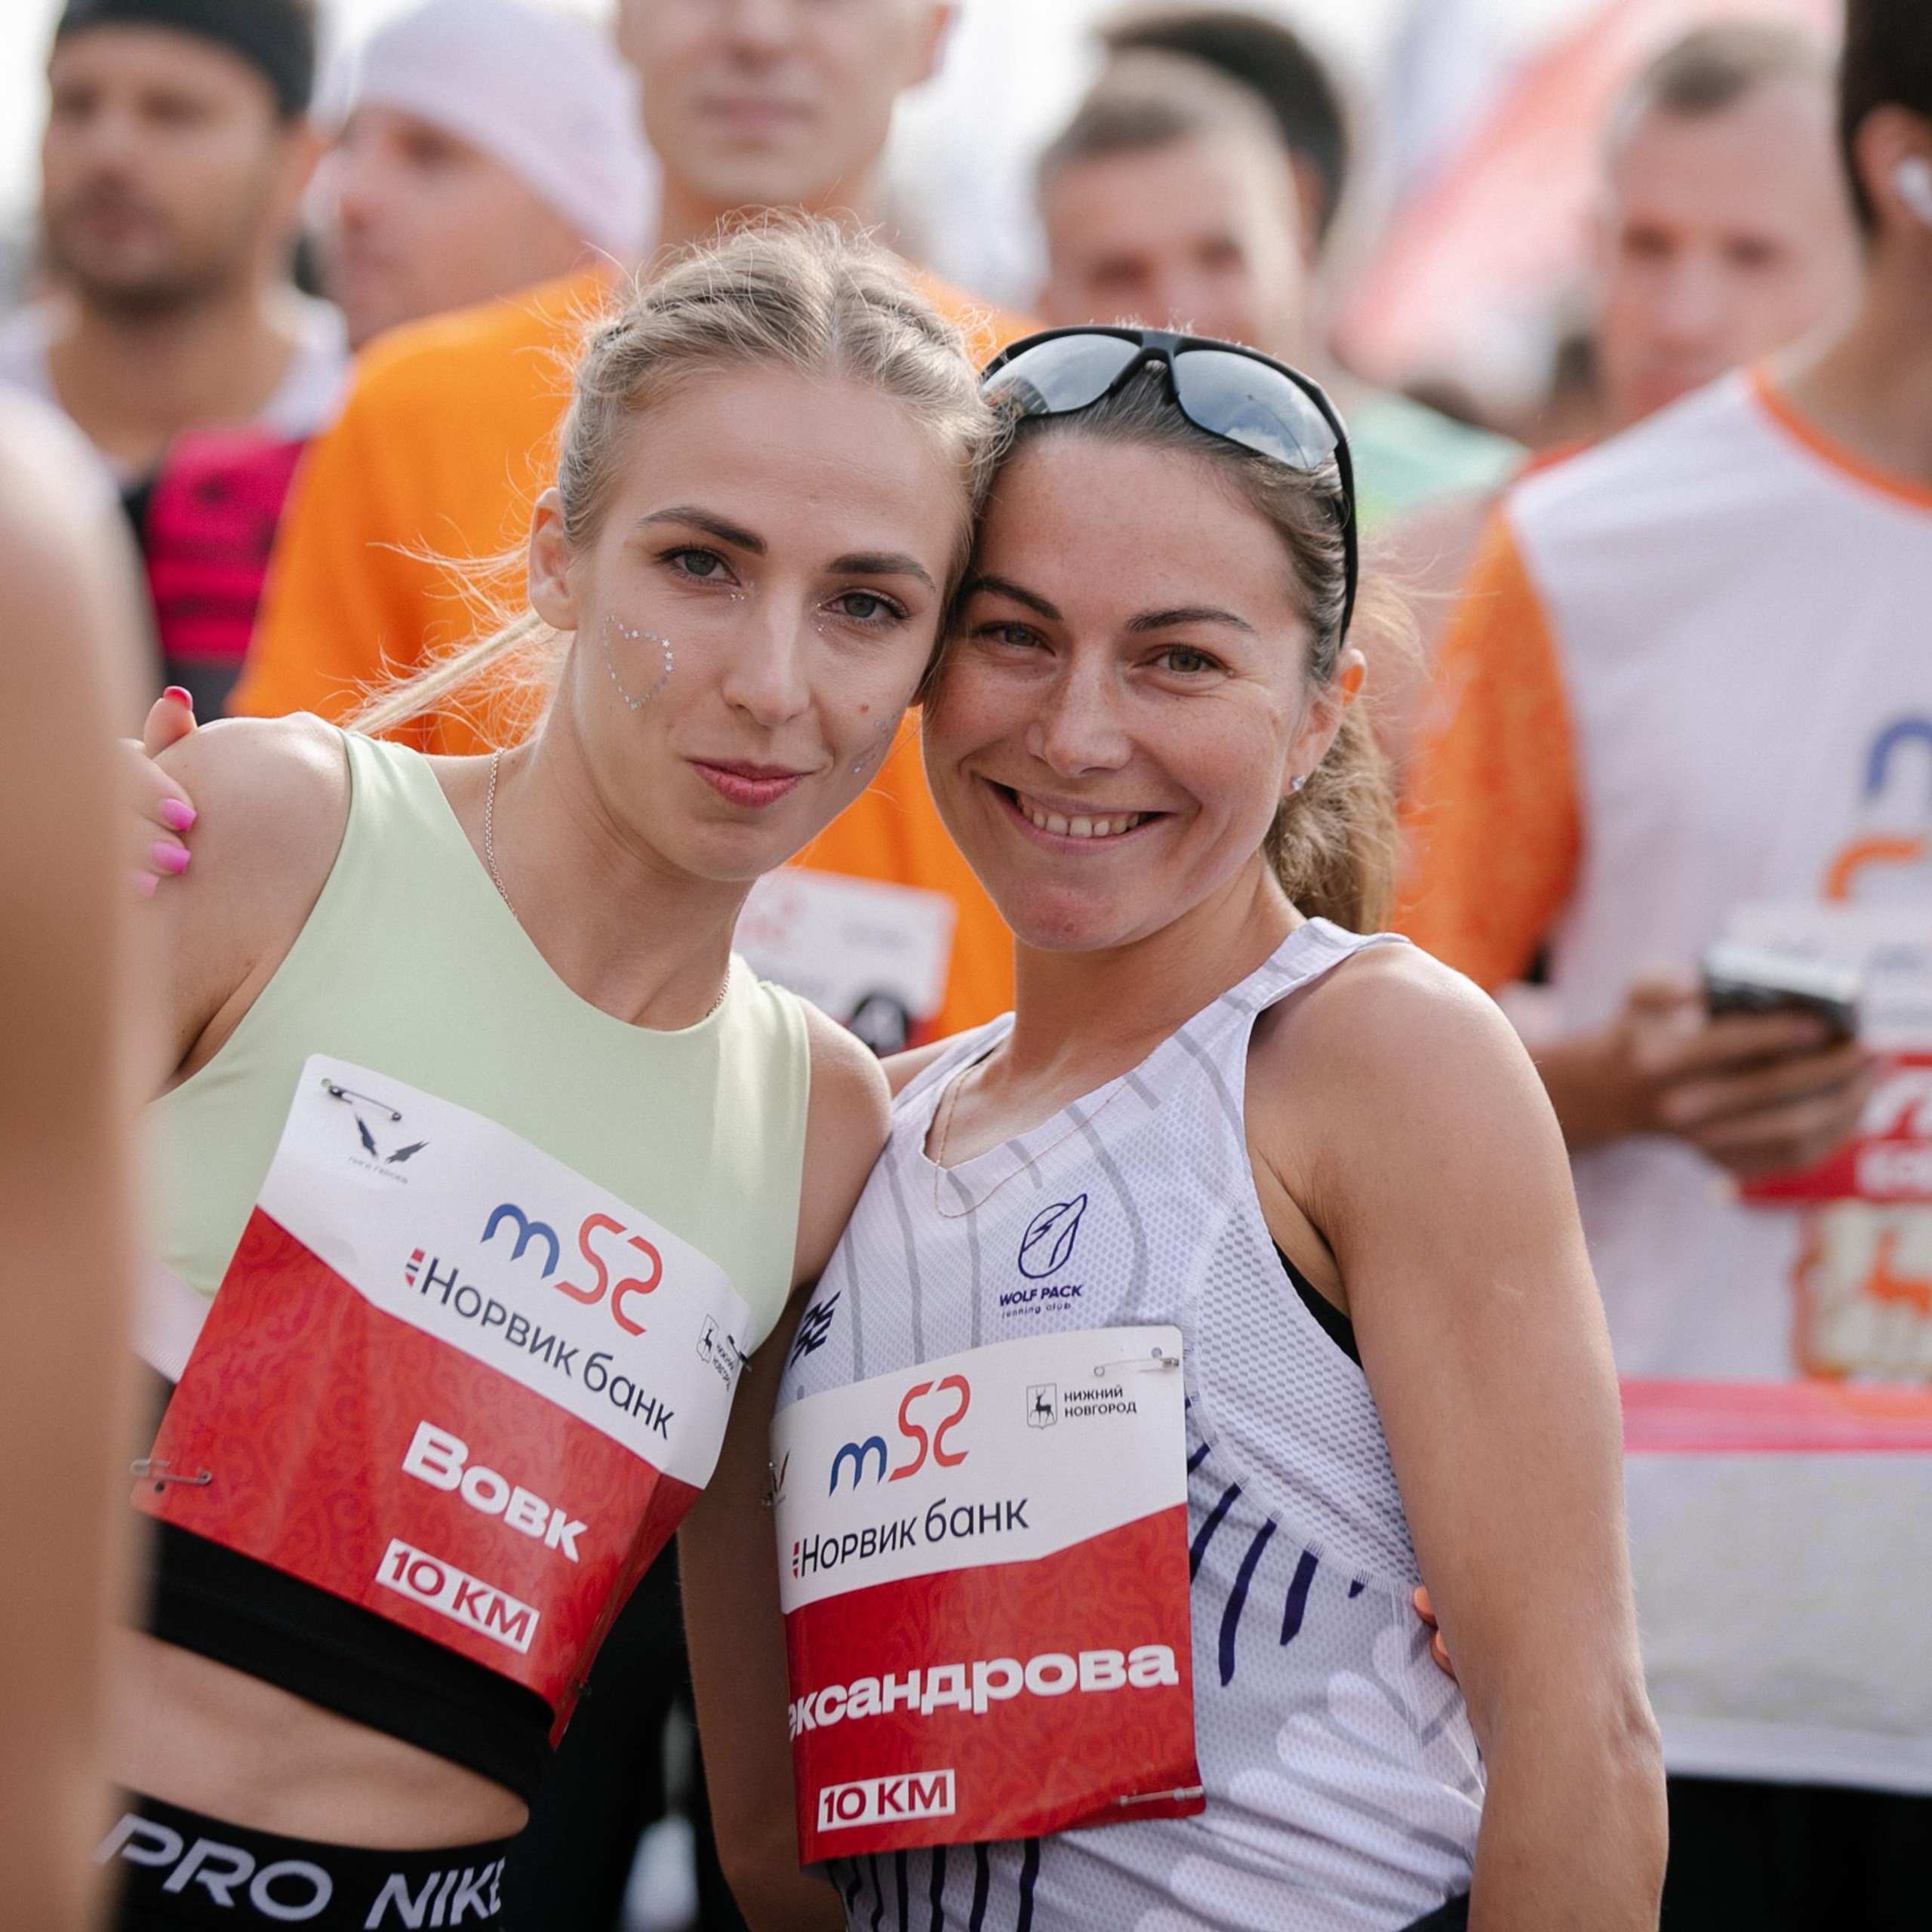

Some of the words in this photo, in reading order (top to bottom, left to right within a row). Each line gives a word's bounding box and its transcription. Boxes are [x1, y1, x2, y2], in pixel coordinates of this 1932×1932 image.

[999, 1288, 1038, 1307] WOLF
[1040, 1284, 1084, 1300] PACK
[1001, 1306, 1041, 1319] running
[1045, 1302, 1072, 1312] club
[583, 1351, 675, 1440] банк
[1064, 1384, 1123, 1402] НИЖНИЙ
[1064, 1401, 1137, 1418] НОВГОРОД
[924, 1497, 1029, 1543] банк
[391, 1549, 445, 1597] 10
[823, 1787, 867, 1824] 10
[93, 1812, 333, 1922] PRO
